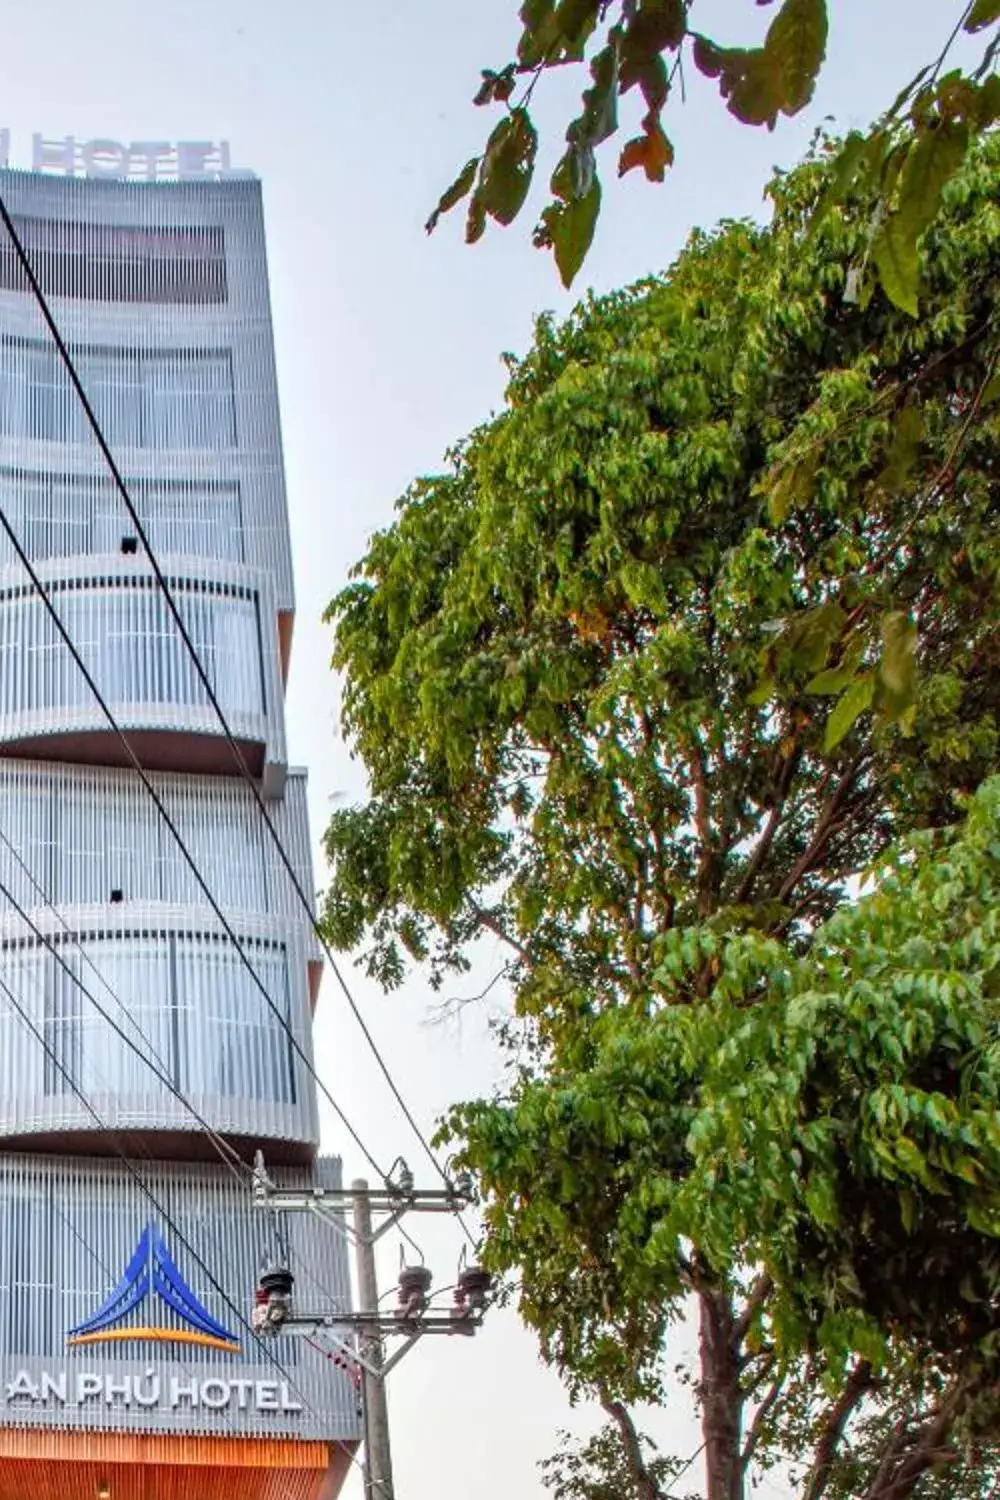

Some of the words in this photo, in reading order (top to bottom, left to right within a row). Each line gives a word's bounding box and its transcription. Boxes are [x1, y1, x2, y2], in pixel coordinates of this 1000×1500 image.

[7, 1368, 66, 1403] AN
[79, 1368, 161, 1405] PHÚ
[171, 1379, 301, 1411] HOTEL
